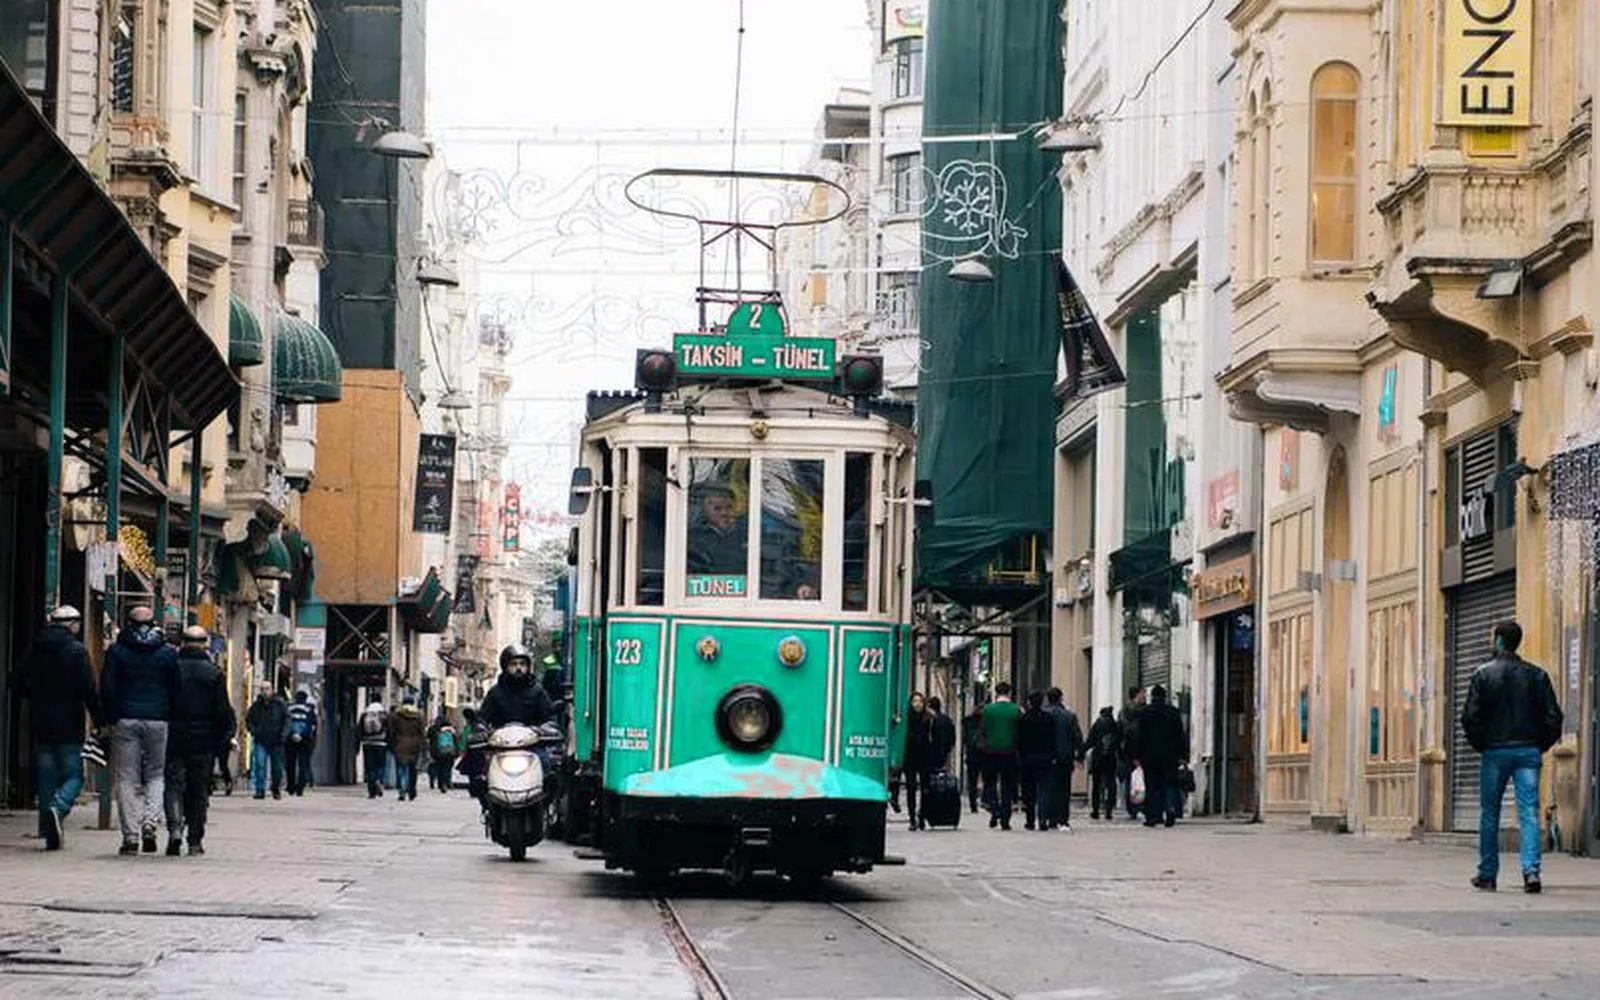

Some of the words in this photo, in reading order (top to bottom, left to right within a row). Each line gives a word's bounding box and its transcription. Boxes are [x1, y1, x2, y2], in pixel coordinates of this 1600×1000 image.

[750, 304, 763, 329] 2
[682, 341, 743, 368] TAKSİM
[773, 343, 831, 371] TÜNEL
[615, 639, 641, 665] 223
[859, 648, 884, 673] 223
